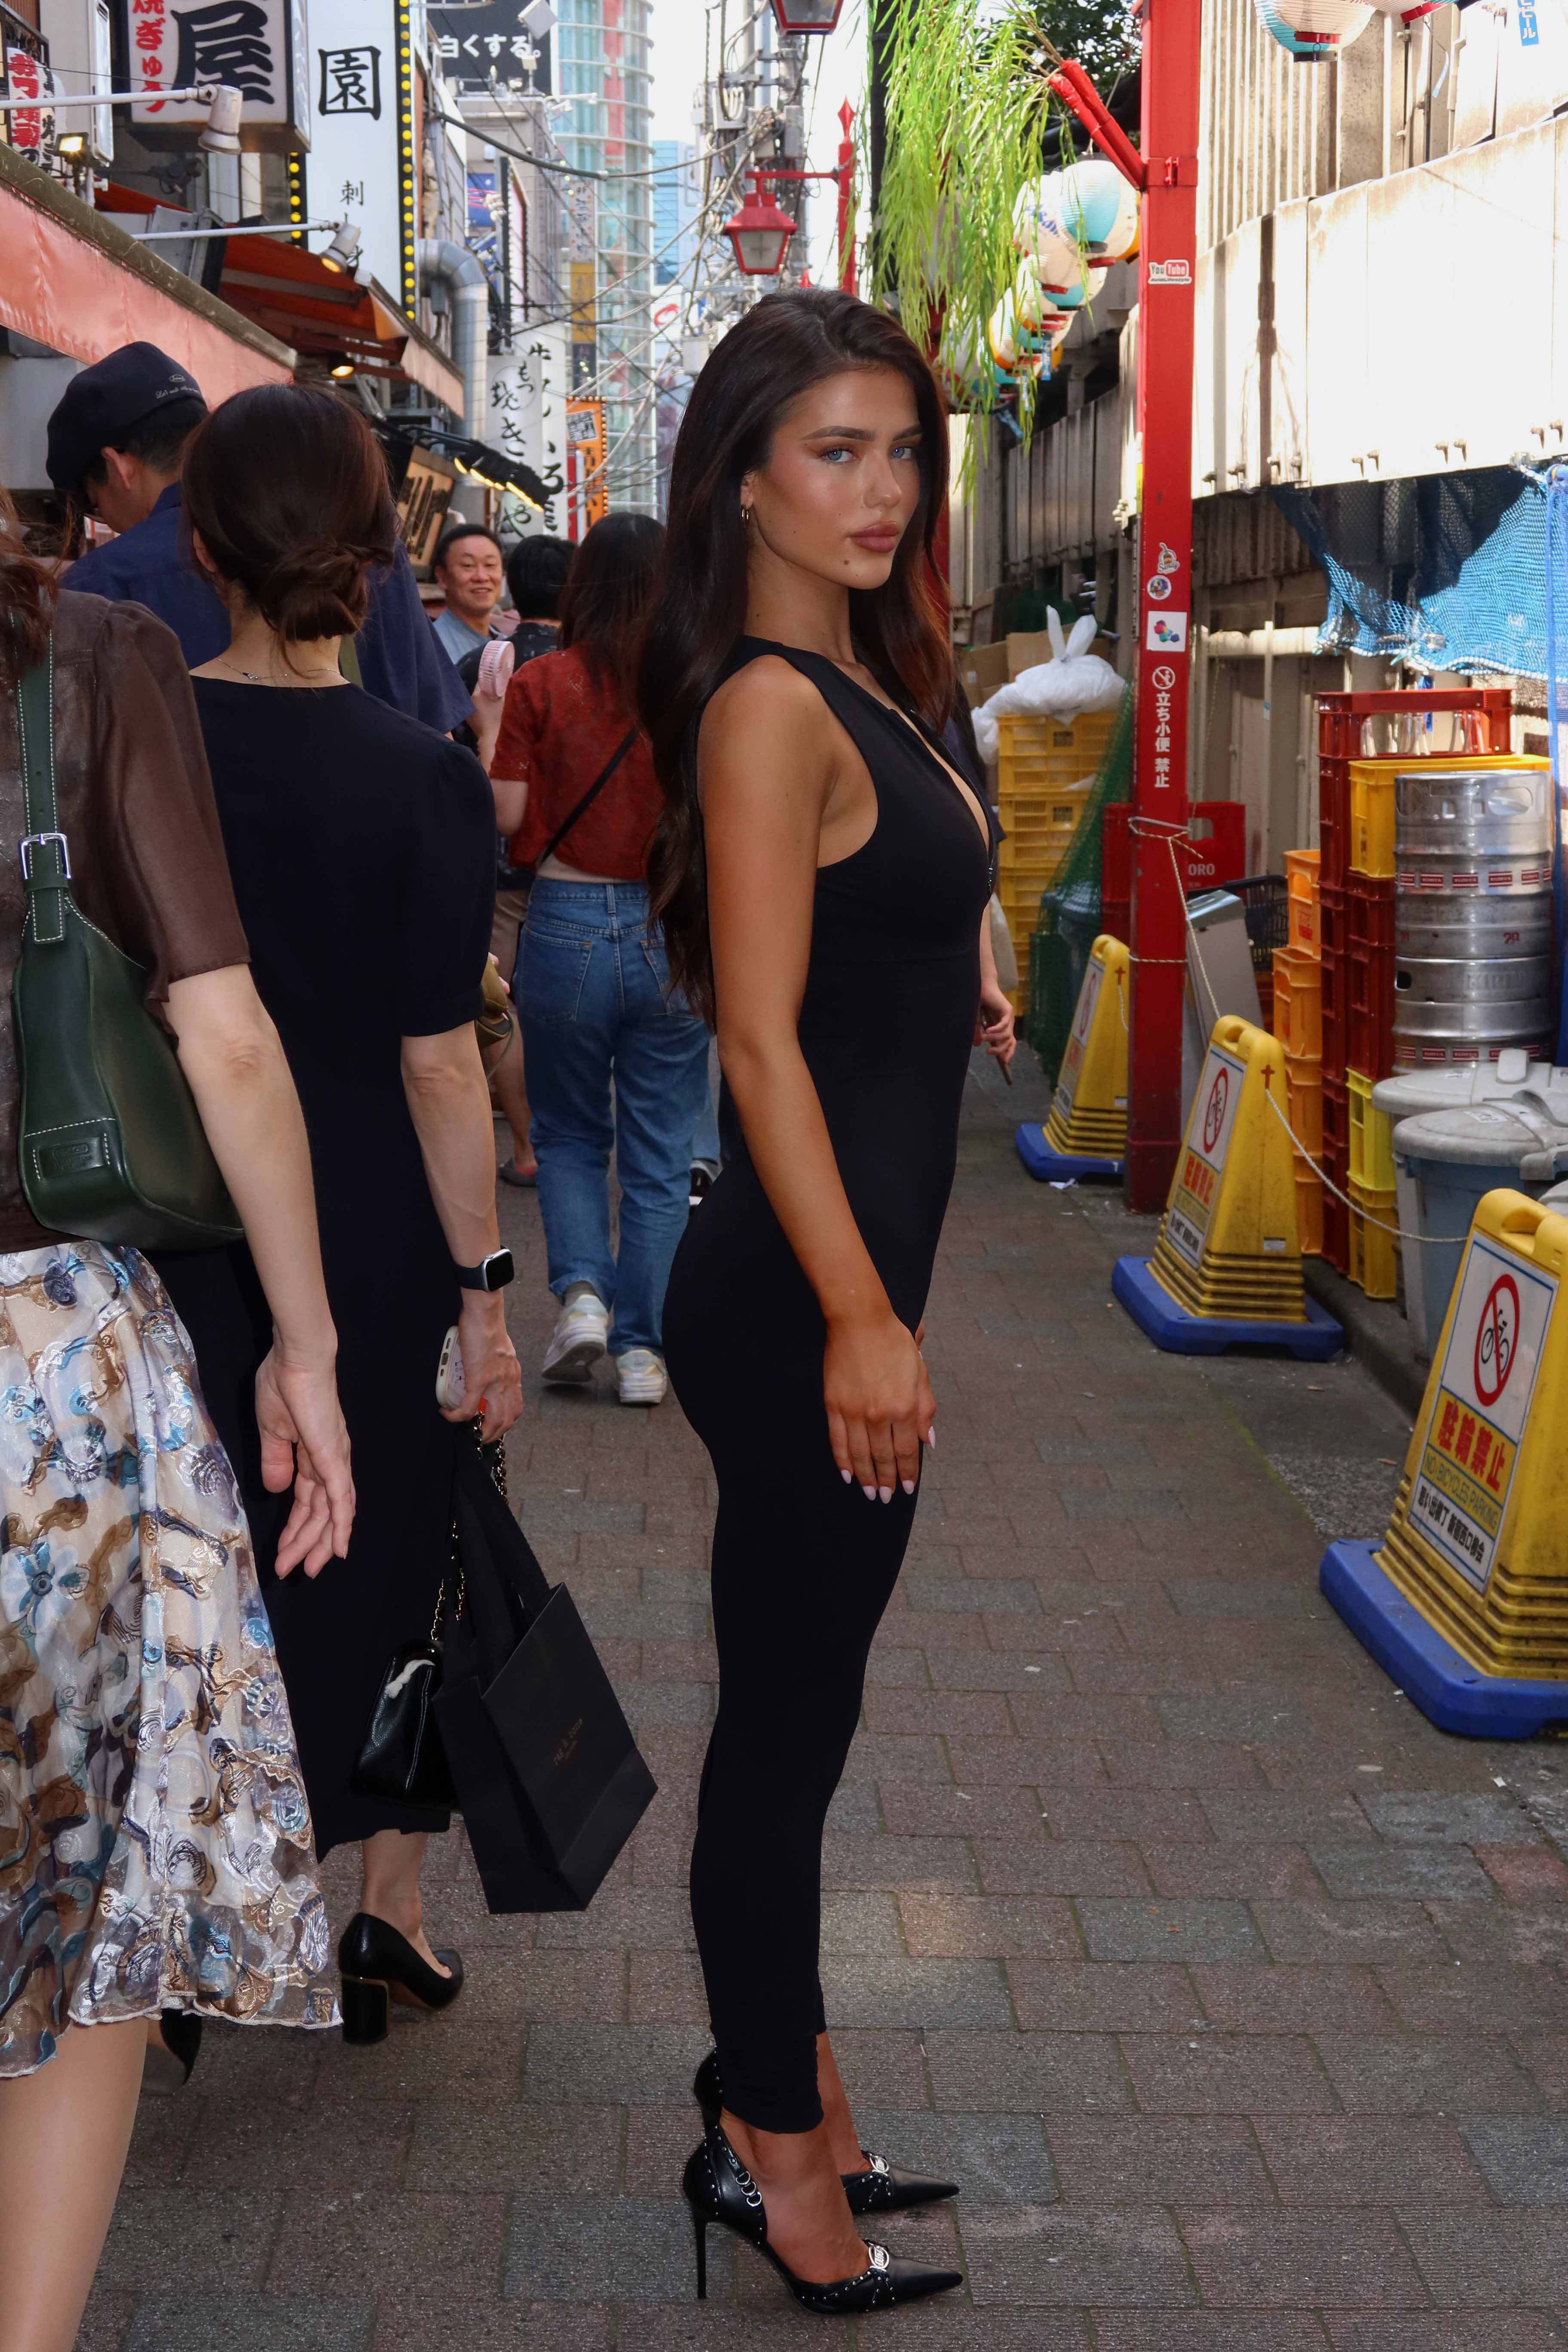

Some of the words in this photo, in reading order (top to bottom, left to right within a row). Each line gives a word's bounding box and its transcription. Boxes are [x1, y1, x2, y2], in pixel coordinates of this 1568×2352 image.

[170, 0, 274, 106] 屋
[318, 46, 382, 120] 園
[1155, 692, 1171, 752] 立ち小便
[1155, 757, 1170, 788] 禁止
[1426, 1452, 1436, 1475] NO
